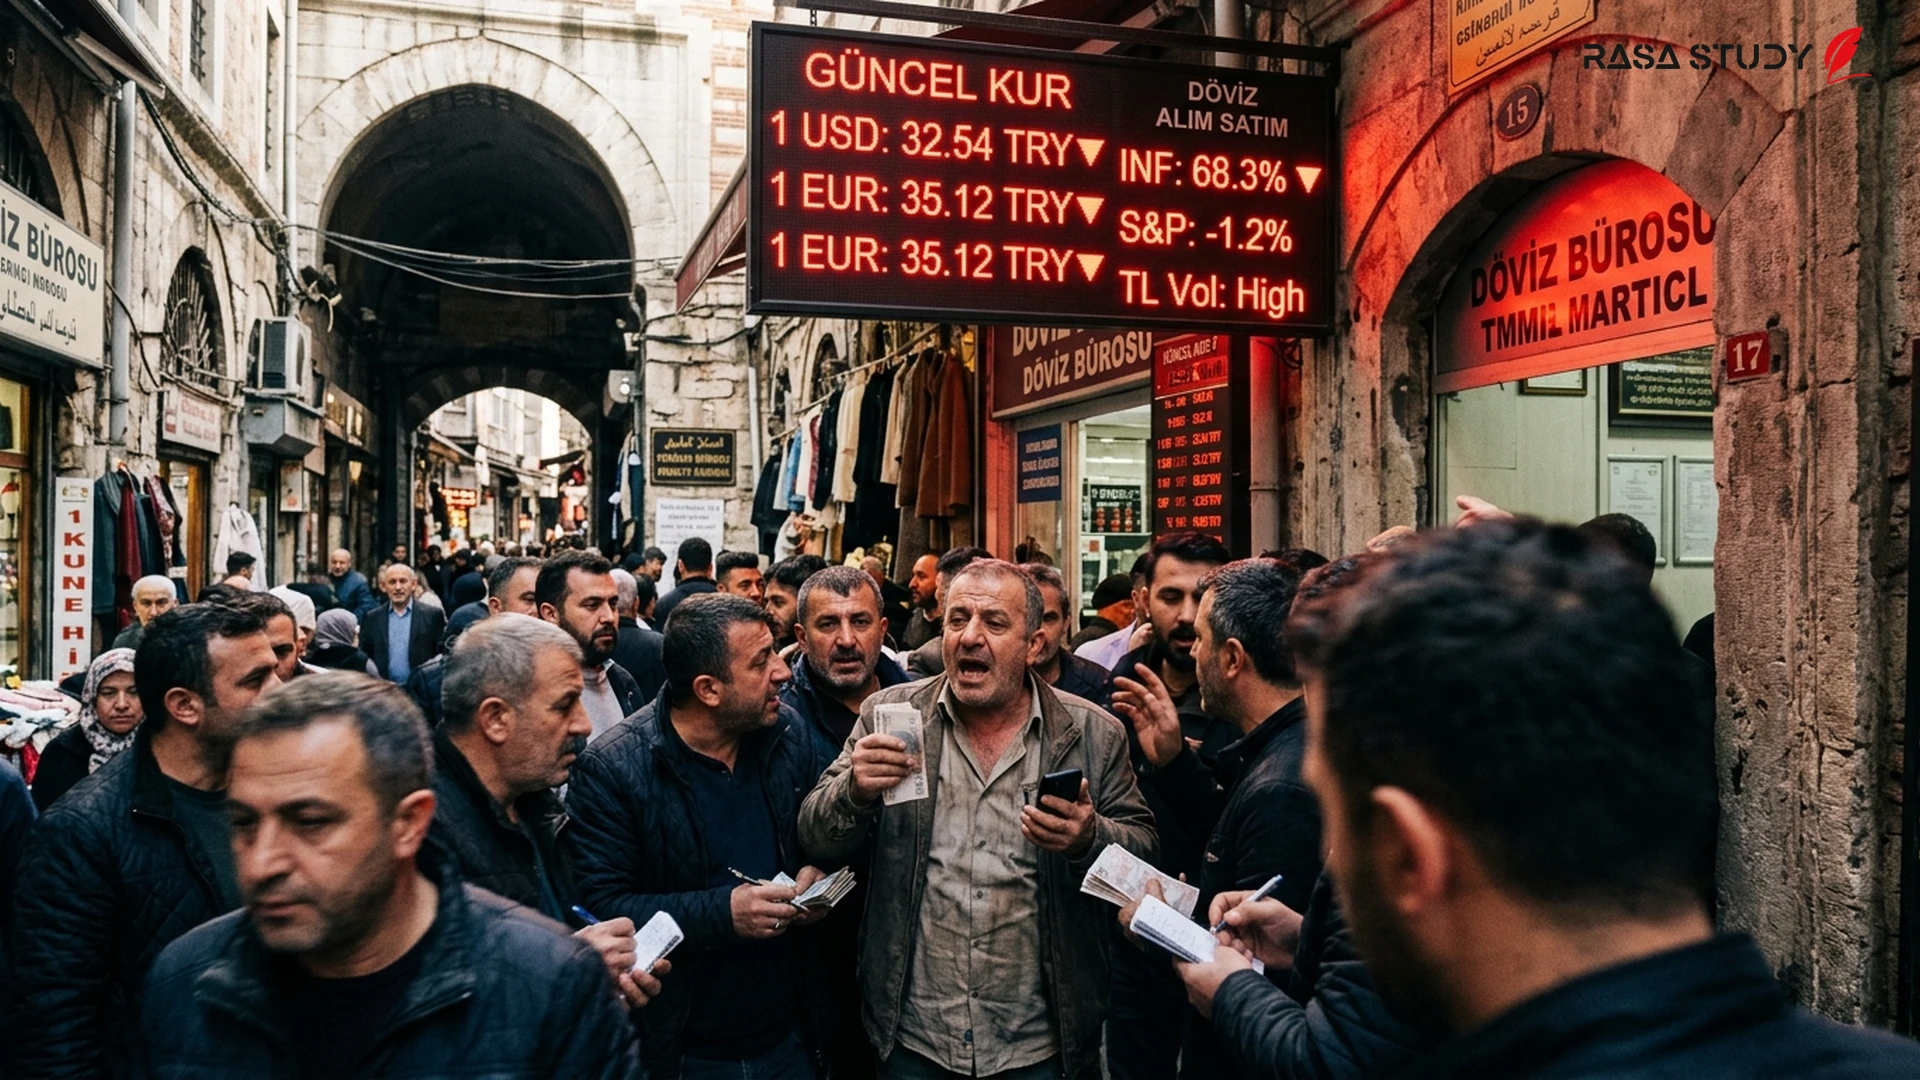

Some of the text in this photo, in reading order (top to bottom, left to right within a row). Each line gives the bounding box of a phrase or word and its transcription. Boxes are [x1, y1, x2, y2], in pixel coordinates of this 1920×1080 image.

[805, 48, 1072, 109] GÜNCEL KUR
[1188, 78, 1259, 107] DÖVİZ
[770, 110, 1074, 166] 1 USD: 32.54 TRY
[1155, 107, 1289, 138] ALIM SATIM
[1505, 96, 1529, 130] 15
[1121, 148, 1287, 193] INF: 68.3%
[770, 170, 1074, 224] 1 EUR: 35.12 TRY
[1119, 209, 1292, 253] S&P: -1.2%
[27, 222, 98, 292] BÜROSU
[770, 231, 785, 268] 1
[803, 234, 889, 273] EUR:
[901, 240, 993, 279] 35.12
[1003, 246, 1074, 282] TRY
[1471, 239, 1558, 308] DÖVİZ
[1119, 269, 1305, 319] TL Vol: High
[1568, 266, 1708, 334] MARTICL
[1732, 339, 1763, 373] 17
